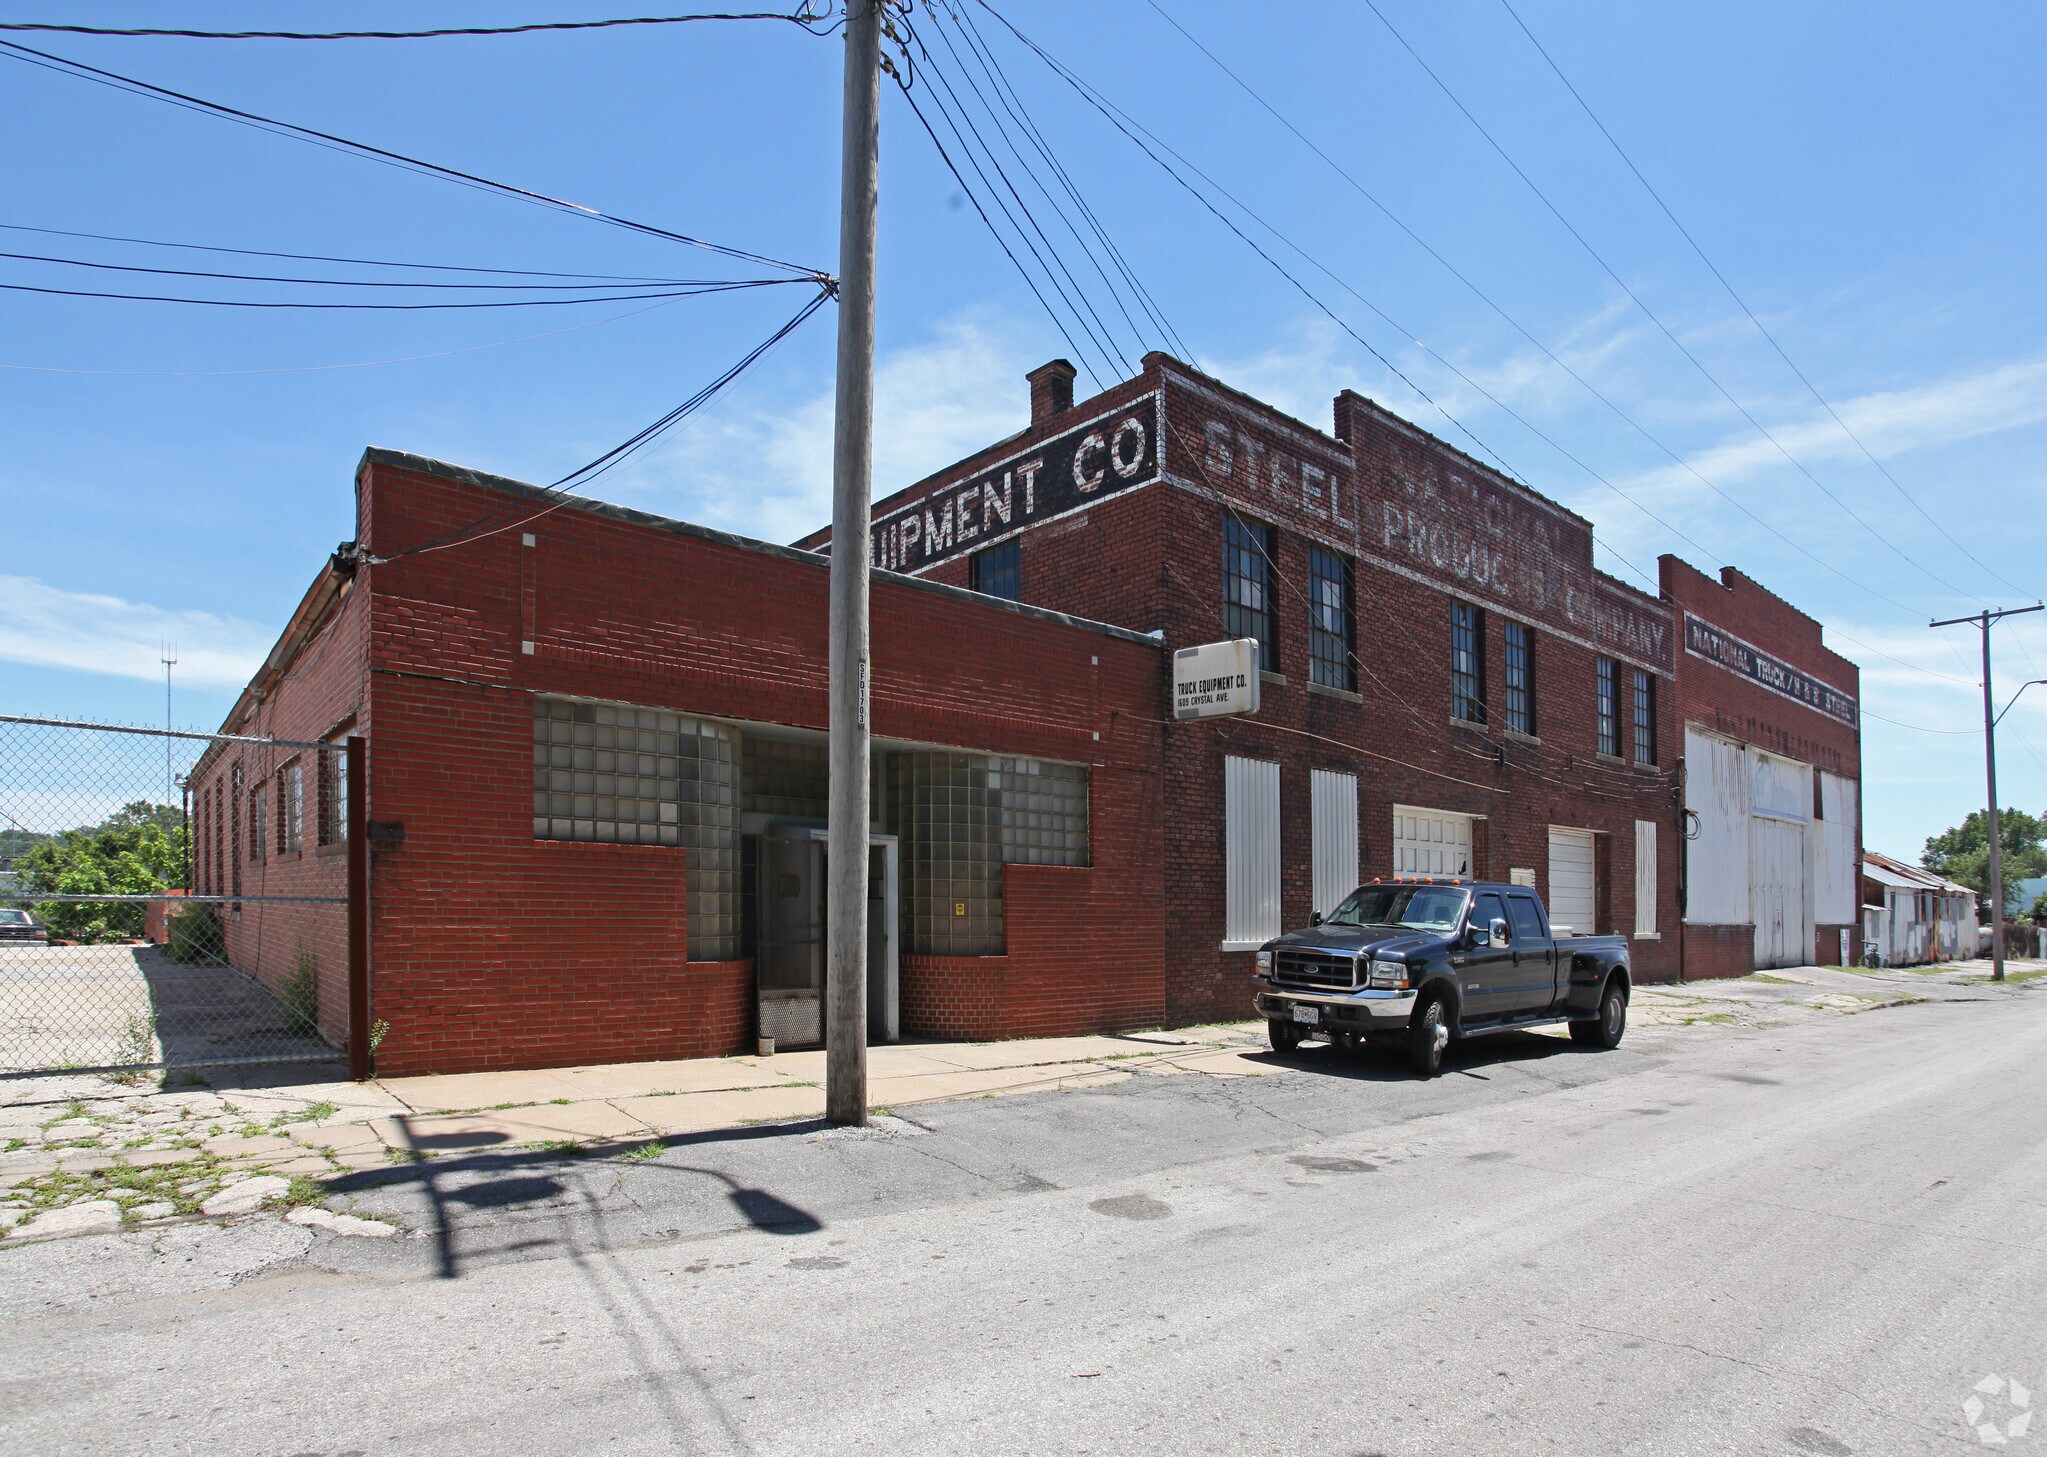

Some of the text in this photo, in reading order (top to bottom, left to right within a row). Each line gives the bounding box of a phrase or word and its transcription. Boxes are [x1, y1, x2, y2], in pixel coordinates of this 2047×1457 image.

[1205, 420, 1354, 532] STEEL
[1383, 500, 1546, 612] PRODUCS
[1178, 674, 1247, 695] TRUCK EQUIPMENT CO.
[1191, 694, 1213, 705] CRYSTAL
[1216, 693, 1229, 702] AVE.
[1692, 625, 1750, 672] NATIONAL
[1825, 693, 1851, 720] STEEL
